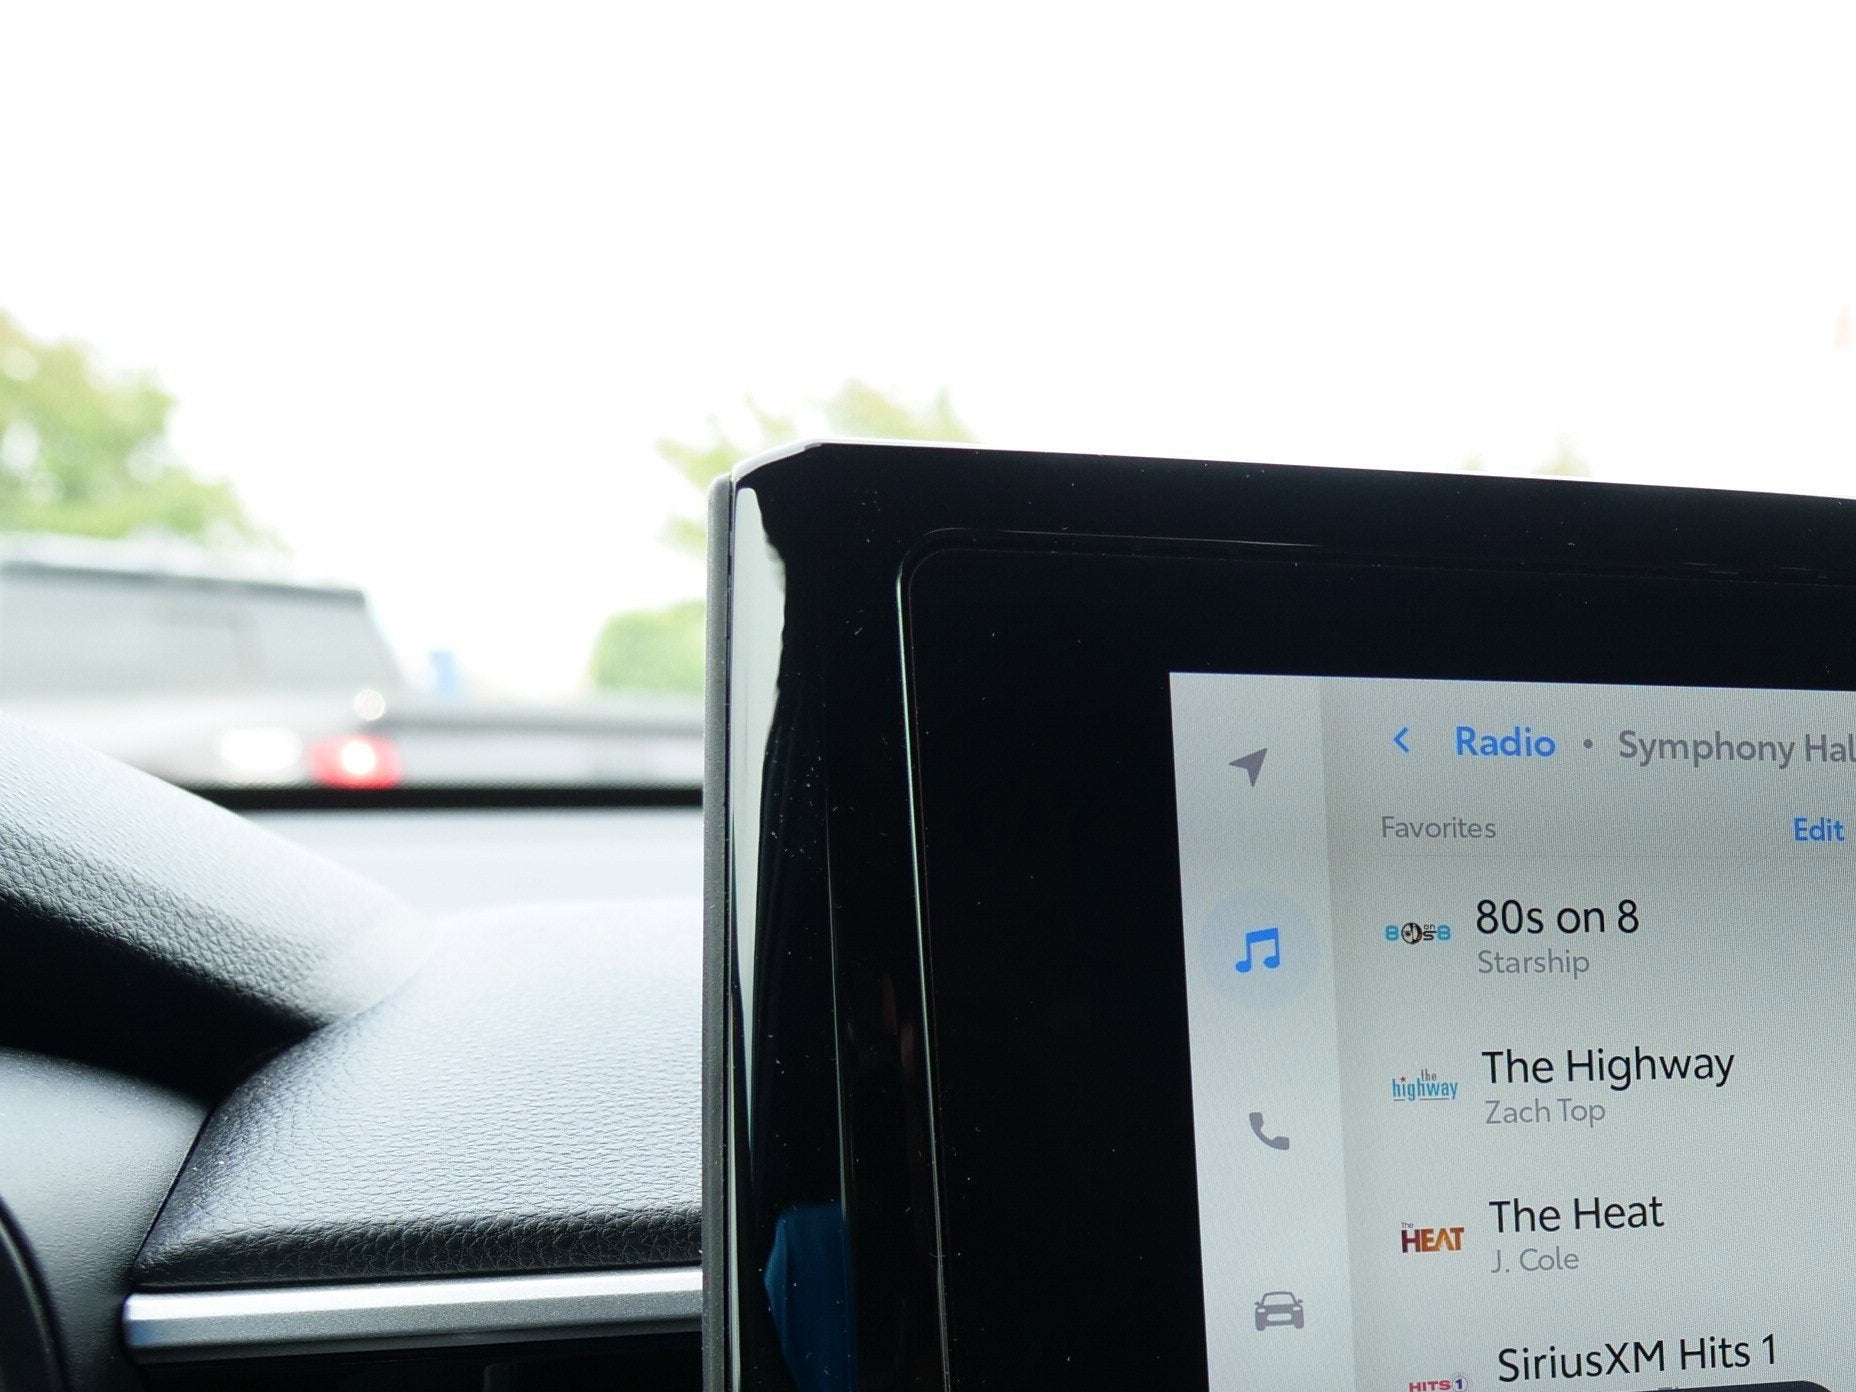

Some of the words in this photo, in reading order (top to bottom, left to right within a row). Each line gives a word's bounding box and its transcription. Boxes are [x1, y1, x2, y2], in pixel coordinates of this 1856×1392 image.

[1455, 725, 1557, 759] Radio
[1618, 730, 1796, 768] Symphony
[1381, 816, 1497, 842] Favorites
[1793, 817, 1846, 843] Edit
[1476, 899, 1545, 936] 80s
[1556, 908, 1607, 935] on
[1616, 899, 1641, 935] 8
[1477, 948, 1591, 979] Starship
[1420, 1068, 1437, 1082] the
[1482, 1050, 1555, 1086] The
[1566, 1045, 1735, 1092] Highway
[1392, 1075, 1458, 1102] highway
[1486, 1100, 1552, 1126] Zach
[1556, 1100, 1606, 1128] Top
[1489, 1199, 1562, 1236] The
[1573, 1194, 1665, 1232] Heat
[1401, 1227, 1465, 1253] HEAT
[1491, 1249, 1513, 1275] J.
[1519, 1247, 1581, 1274] Cole
[1497, 1339, 1666, 1383] SiriusXM
[1680, 1335, 1752, 1373] Hits
[1762, 1334, 1778, 1367] 1
